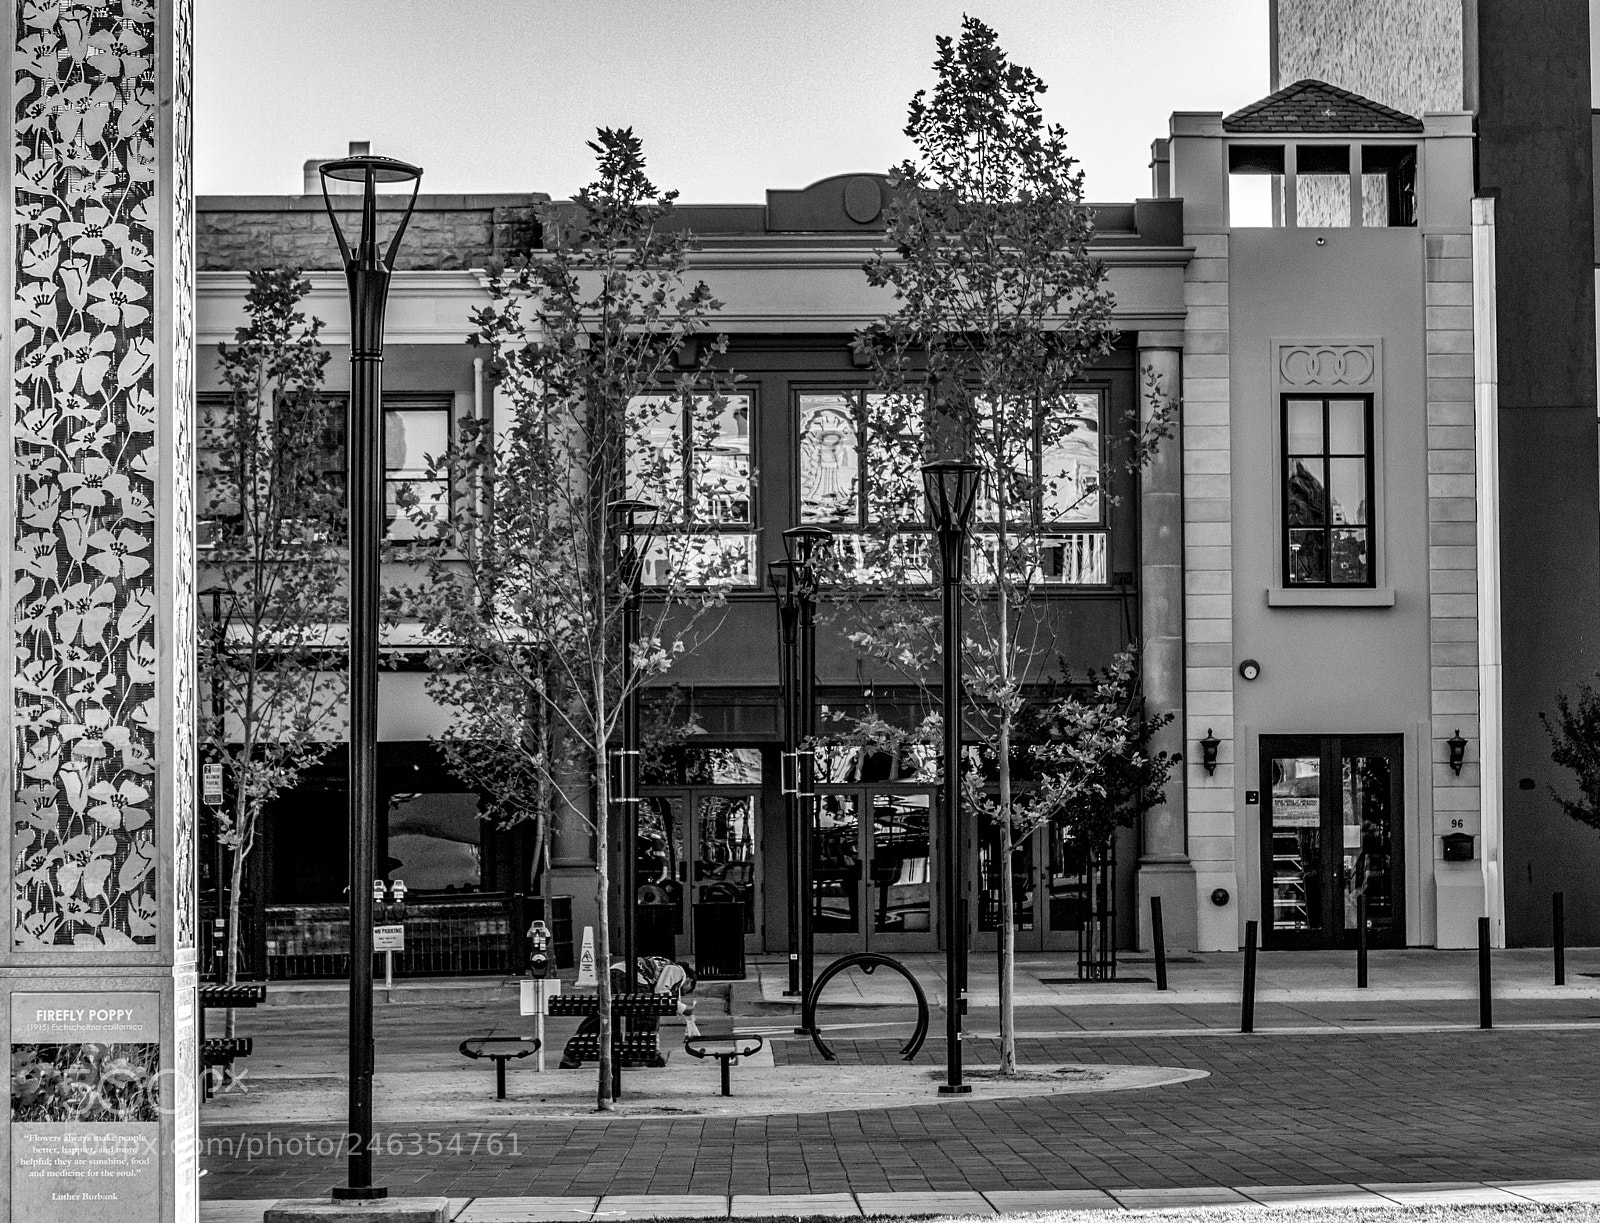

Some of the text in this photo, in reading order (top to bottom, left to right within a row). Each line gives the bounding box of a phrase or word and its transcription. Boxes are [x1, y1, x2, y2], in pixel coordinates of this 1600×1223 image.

[1451, 819, 1464, 829] 96
[36, 1009, 133, 1021] FIREFLY POPPY
[26, 1023, 50, 1032] (1915)
[102, 1023, 144, 1031] californica
[64, 1134, 91, 1144] always
[93, 1134, 116, 1142] make
[118, 1134, 147, 1143] people
[32, 1146, 60, 1154] better,
[61, 1146, 97, 1156] happier,
[98, 1146, 114, 1154] and
[20, 1158, 53, 1167] helpful;
[54, 1158, 72, 1167] they
[88, 1158, 129, 1167] sunshine,
[131, 1157, 150, 1166] food
[28, 1169, 45, 1177] and
[46, 1169, 85, 1177] medicine
[87, 1169, 100, 1177] for
[101, 1169, 114, 1177] the
[51, 1192, 119, 1201] Luther Burbank
